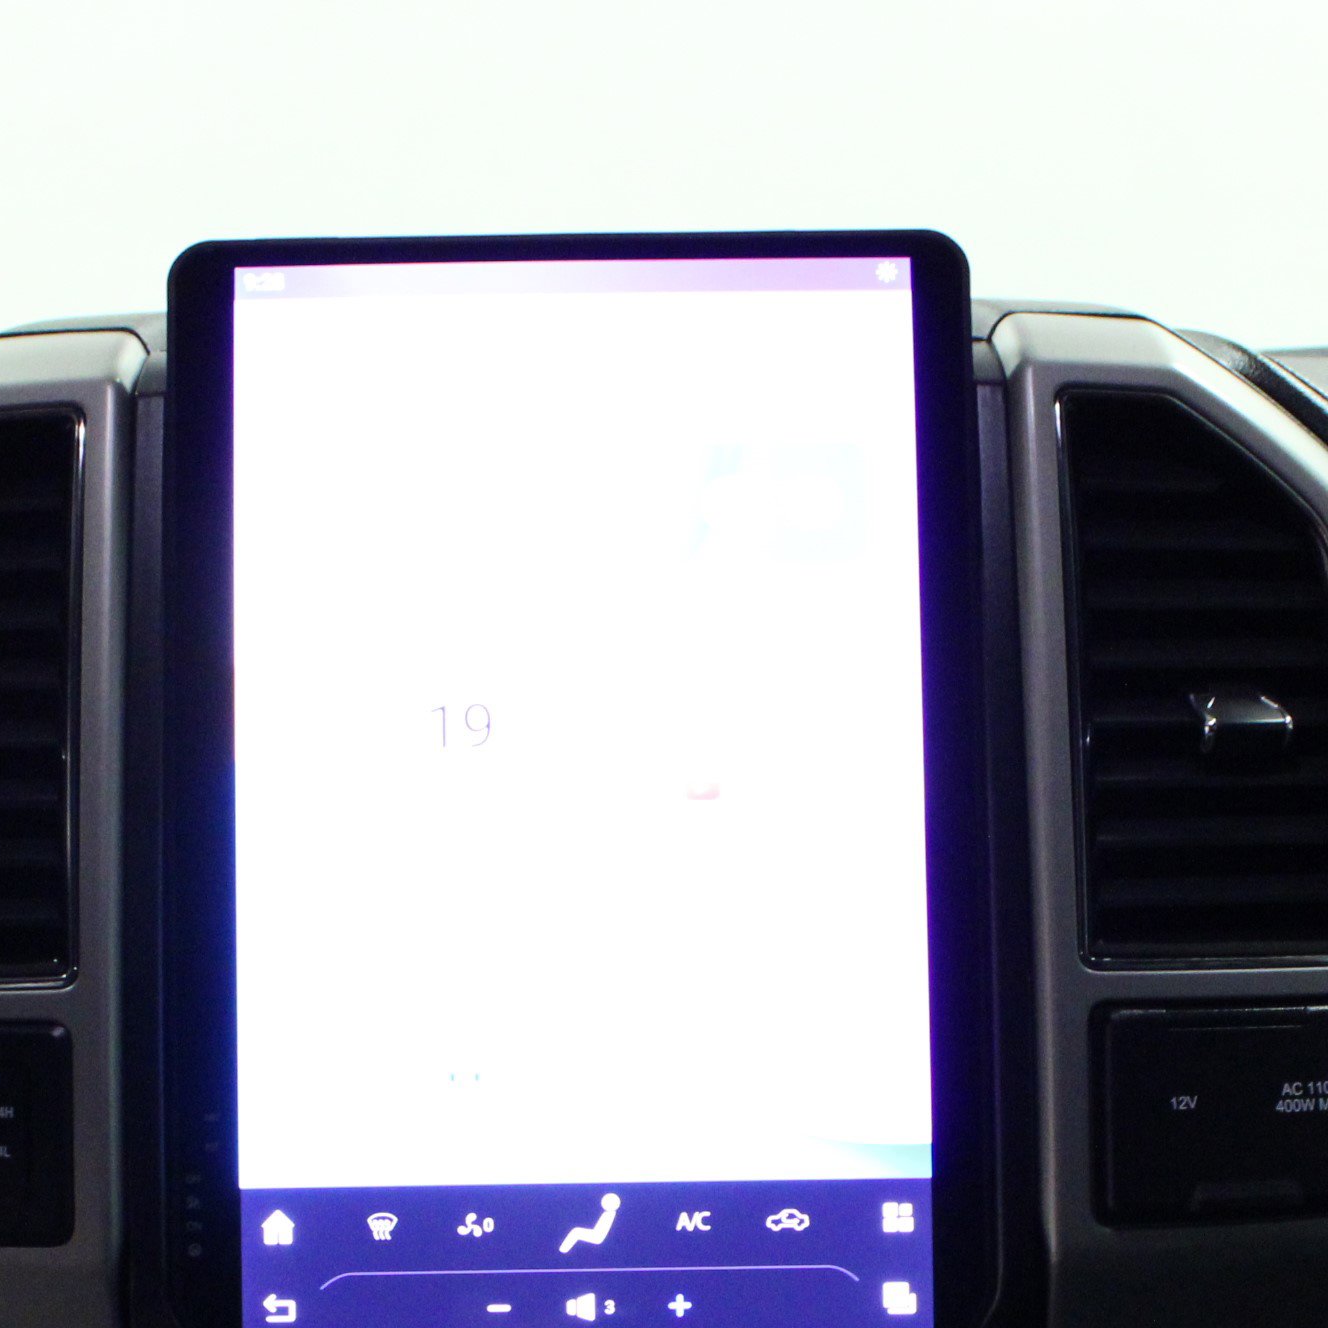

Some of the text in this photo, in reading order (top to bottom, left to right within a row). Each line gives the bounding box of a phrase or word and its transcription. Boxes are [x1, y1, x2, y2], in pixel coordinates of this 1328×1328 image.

[431, 703, 492, 748] 19
[1281, 1082, 1303, 1096] AC
[1170, 1096, 1198, 1110] 12V
[1275, 1097, 1315, 1113] 400W
[483, 1217, 495, 1233] 0
[675, 1211, 712, 1232] A/C
[604, 1299, 616, 1316] 3
